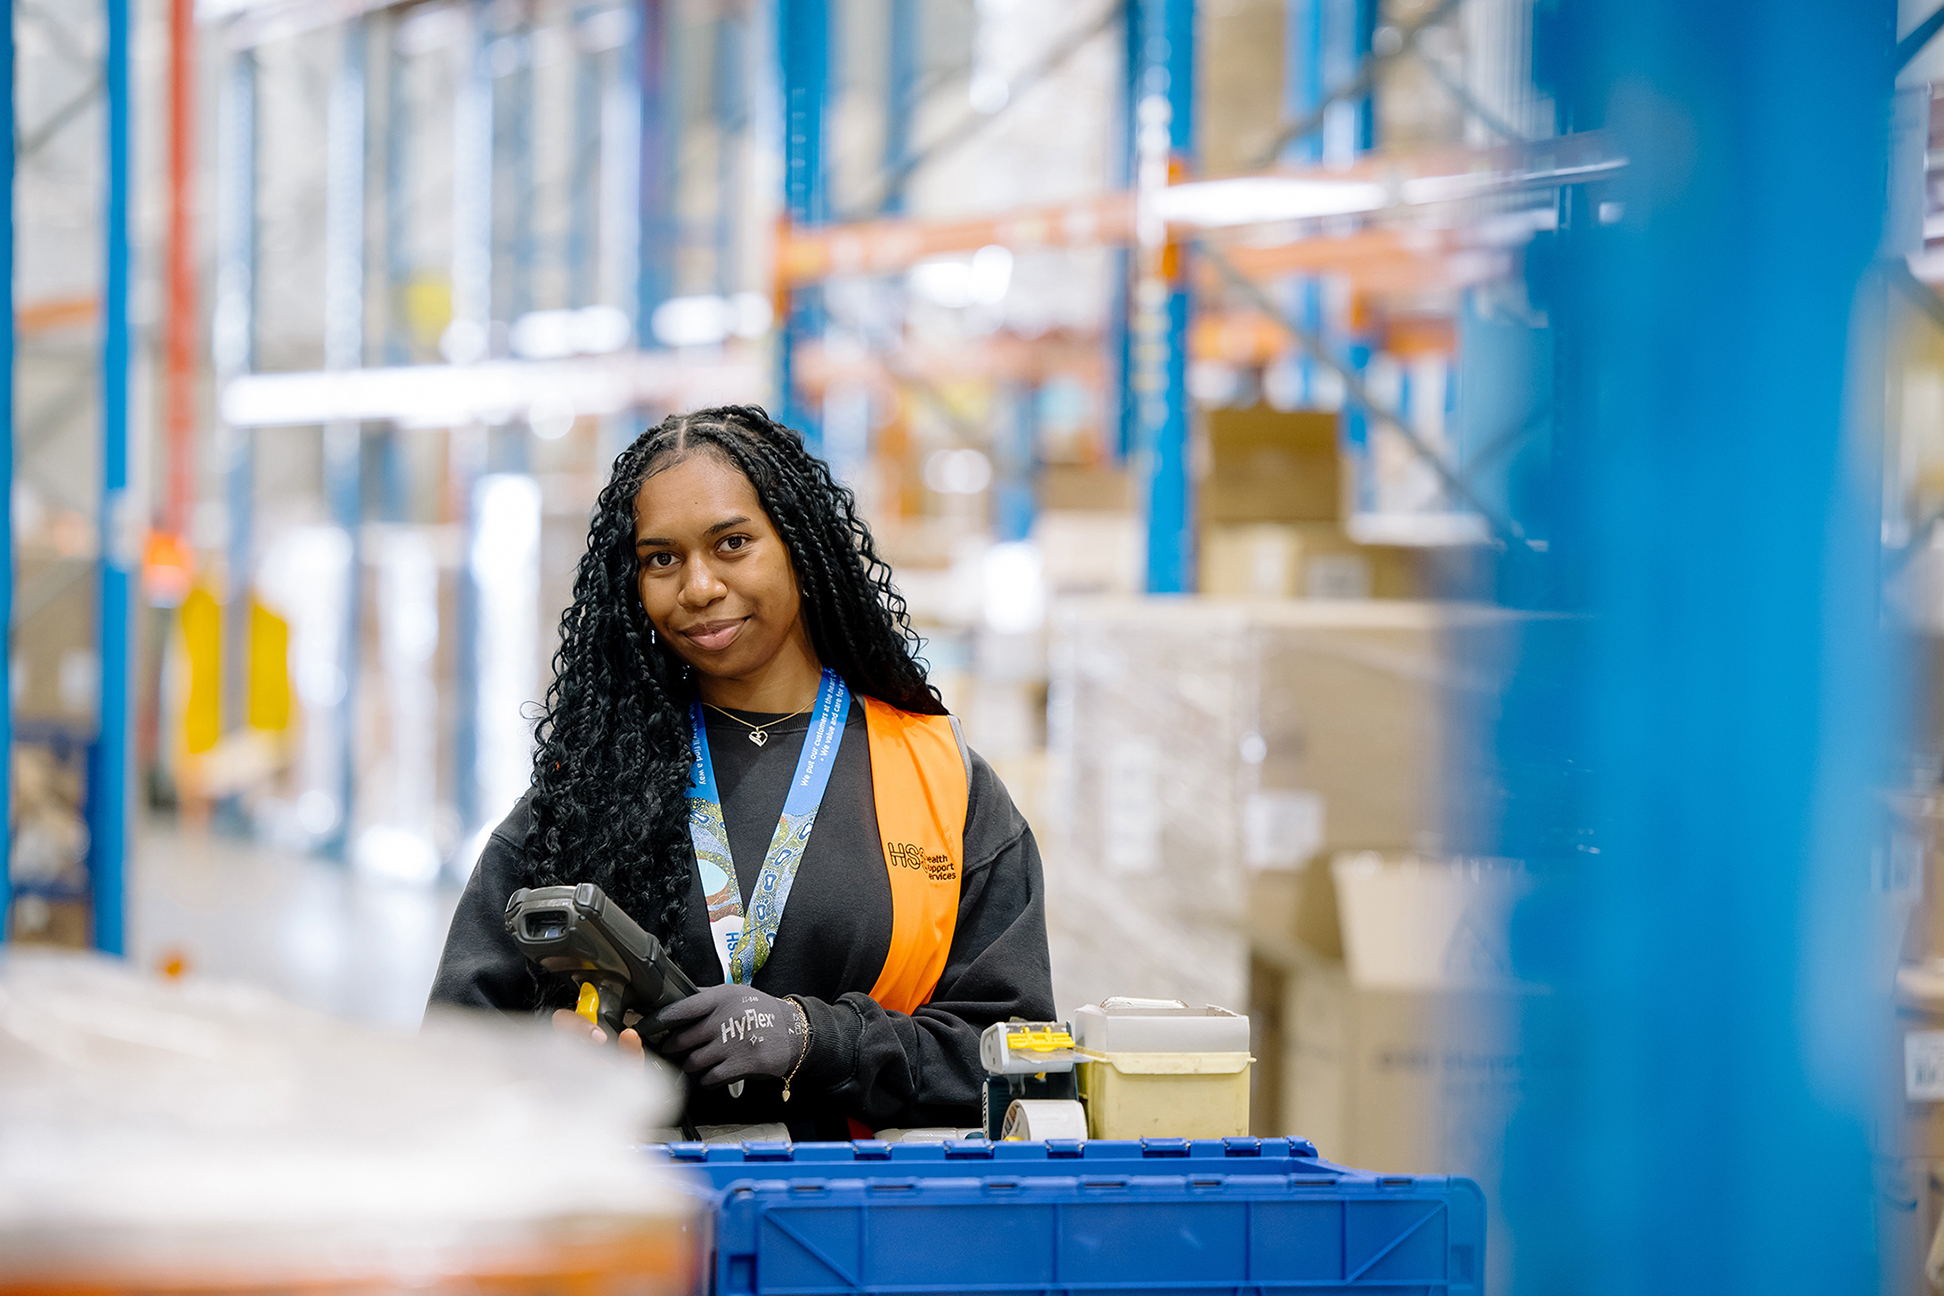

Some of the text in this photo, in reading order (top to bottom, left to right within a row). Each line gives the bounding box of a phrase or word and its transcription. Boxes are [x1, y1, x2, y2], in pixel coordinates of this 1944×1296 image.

[827, 678, 836, 694] heart
[835, 687, 845, 698] for
[824, 693, 833, 705] the
[834, 698, 842, 712] care
[823, 704, 830, 712] at
[830, 712, 839, 726] and
[813, 712, 829, 747] customers
[825, 726, 835, 744] value
[693, 745, 703, 762] find
[810, 746, 819, 760] our
[820, 744, 830, 757] We
[806, 760, 815, 774] put
[800, 774, 811, 787] We
[927, 854, 948, 864] ealth
[927, 863, 955, 873] upport
[929, 872, 956, 880] ervices
